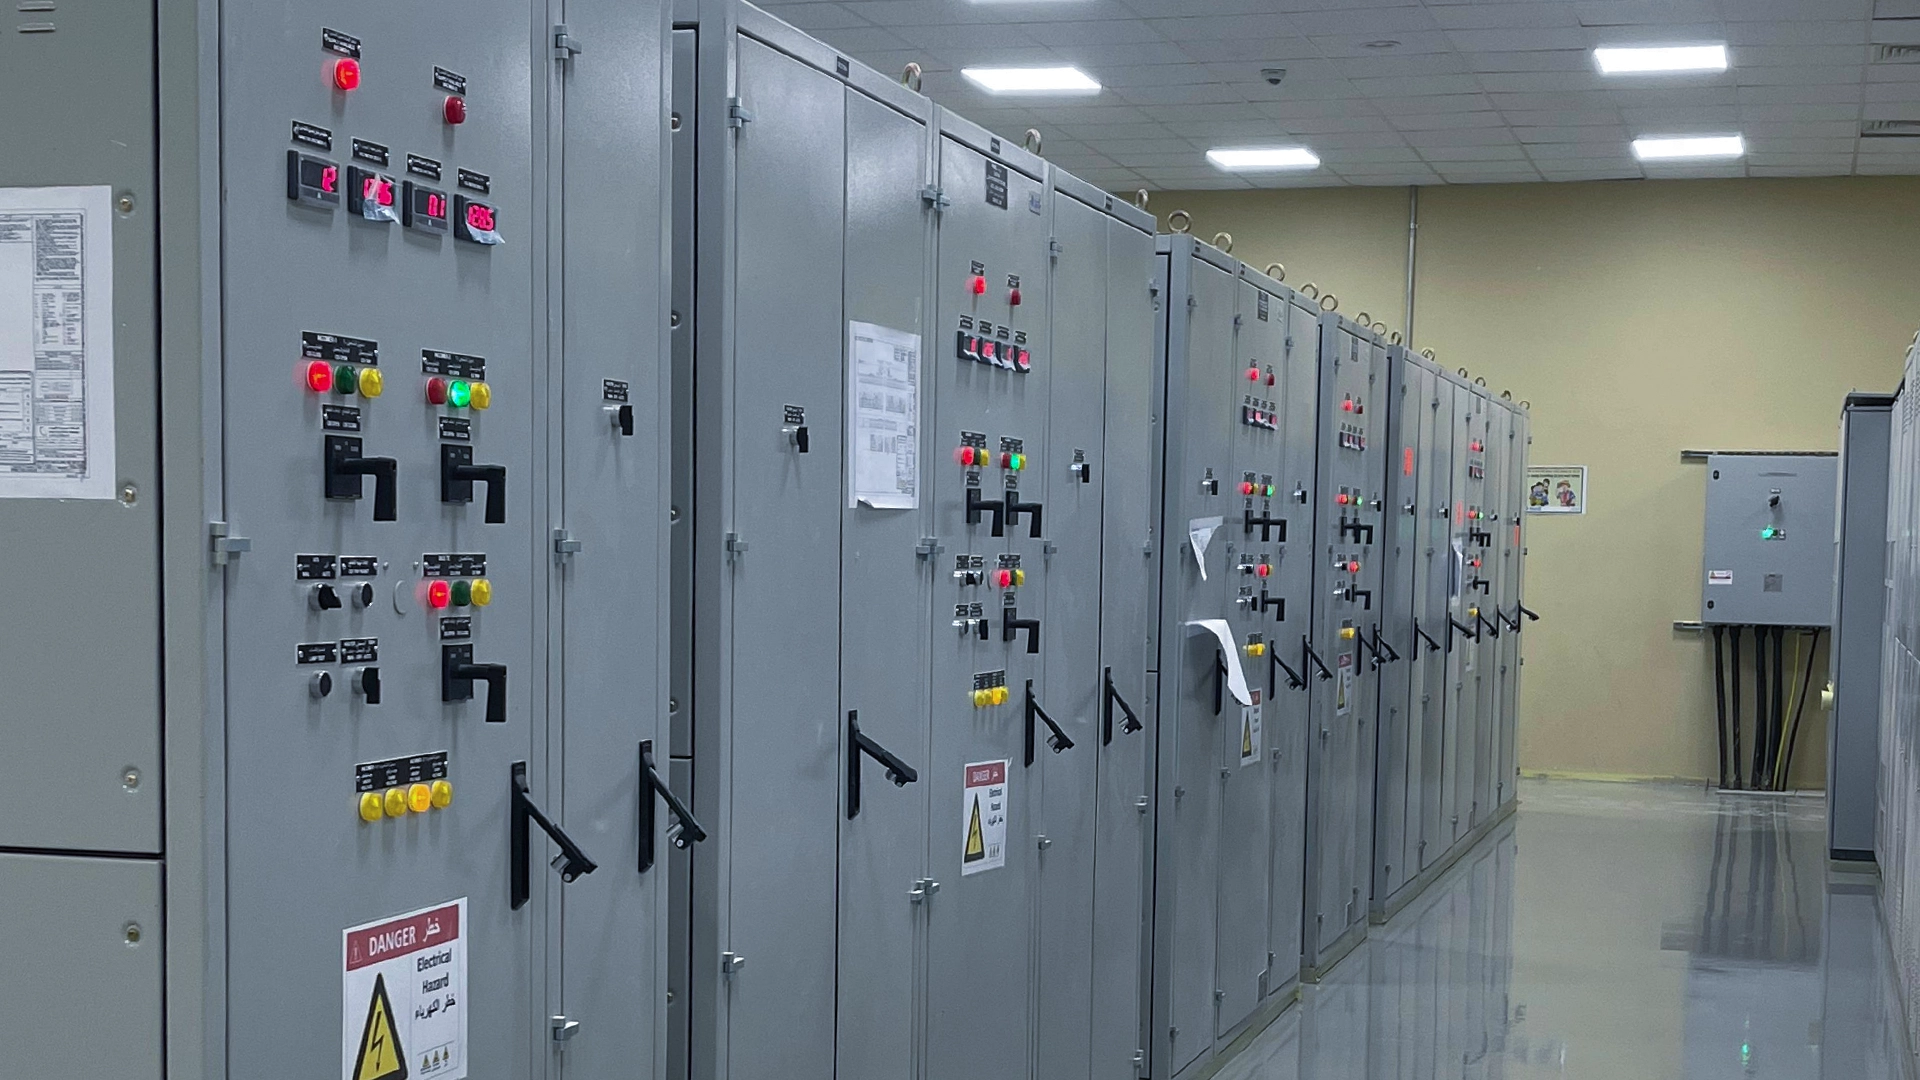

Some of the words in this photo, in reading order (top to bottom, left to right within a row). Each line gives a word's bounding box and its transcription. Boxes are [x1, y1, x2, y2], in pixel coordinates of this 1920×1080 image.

[369, 925, 416, 957] DANGER
[422, 916, 441, 943] خطر
[417, 947, 452, 972] Electrical
[422, 972, 449, 994] Hazard
